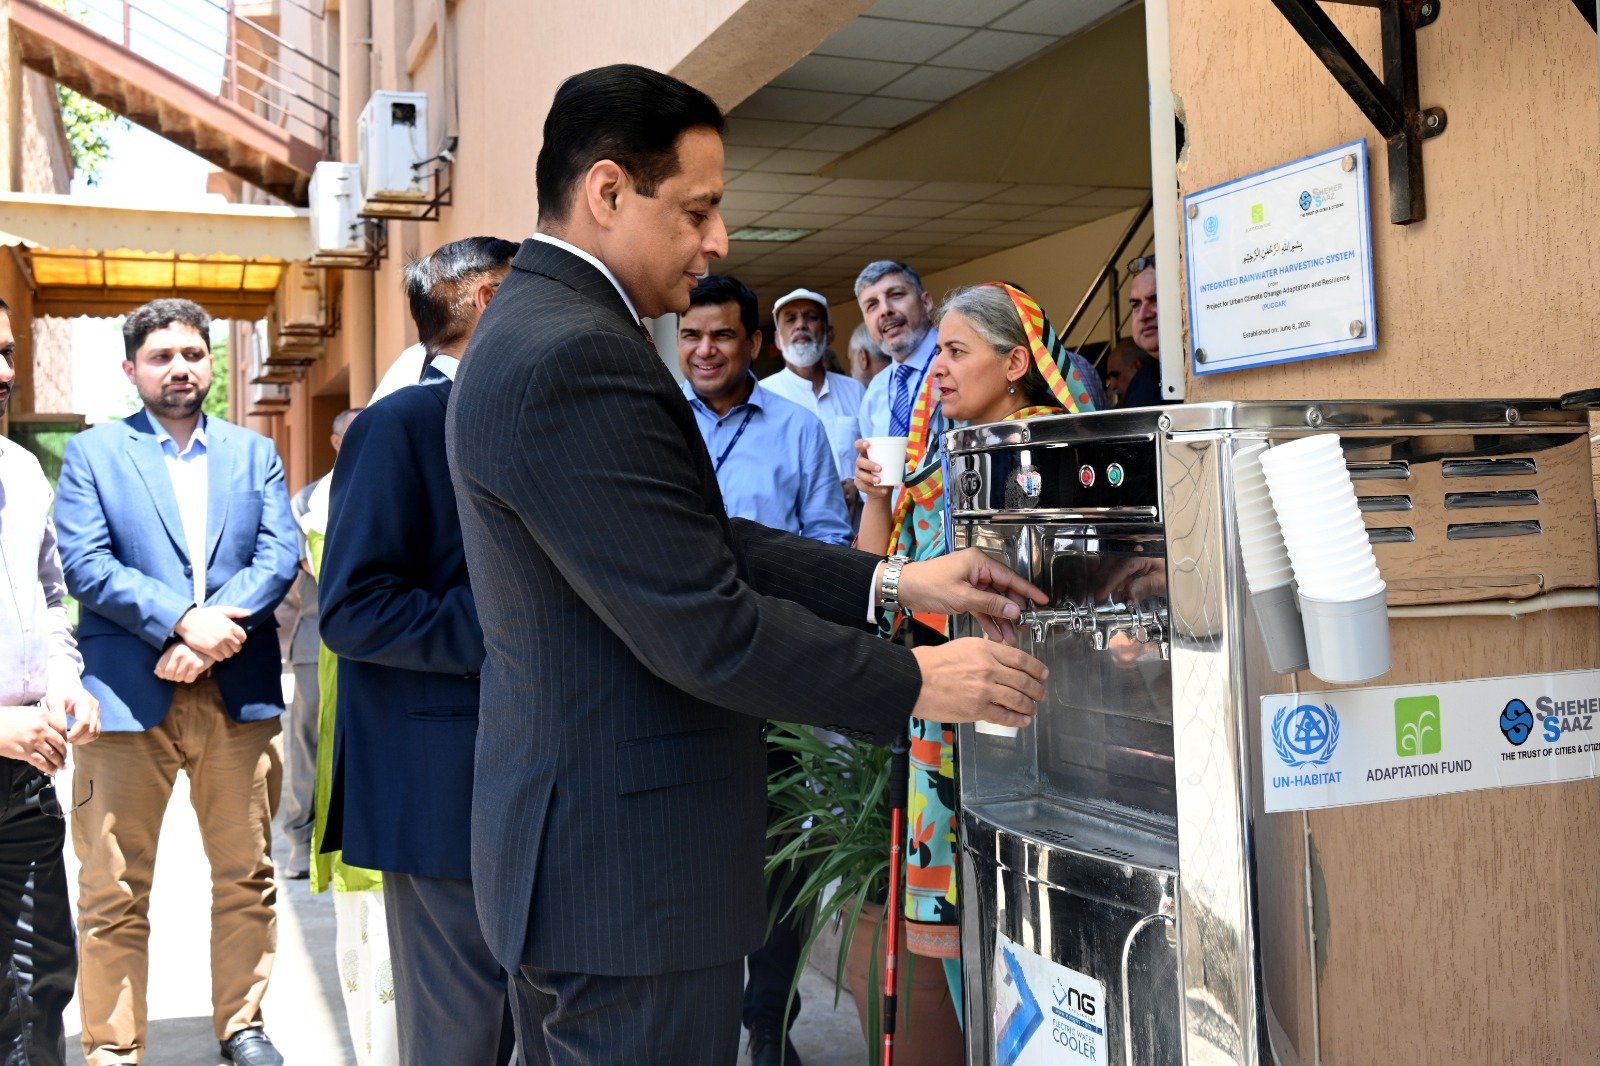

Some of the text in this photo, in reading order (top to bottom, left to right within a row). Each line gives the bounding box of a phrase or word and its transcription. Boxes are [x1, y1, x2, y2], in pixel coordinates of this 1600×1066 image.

[1200, 250, 1356, 293] INTEGRATED RAINWATER HARVESTING SYSTEM
[1206, 302, 1222, 311] Project
[1229, 298, 1243, 306] Urban
[1244, 293, 1262, 303] Climate
[1263, 290, 1282, 299] Change
[1283, 283, 1311, 294] Adaptation
[1312, 280, 1321, 288] and
[1322, 275, 1350, 286] Resilience
[1242, 327, 1270, 339] Established
[1280, 324, 1291, 333] June
[1543, 715, 1593, 742] SAAZ
[1501, 752, 1515, 761] THE
[1517, 749, 1541, 759] TRUST
[1542, 748, 1552, 757] OF
[1554, 745, 1576, 756] CITIES
[1577, 744, 1582, 753] &
[1273, 771, 1342, 788] UN-HABITAT
[1366, 759, 1472, 782] ADAPTATION FUND
[1053, 1018, 1075, 1036] ELECTRIC
[1077, 1031, 1095, 1045] WATER
[1053, 1027, 1096, 1061] COOLER
